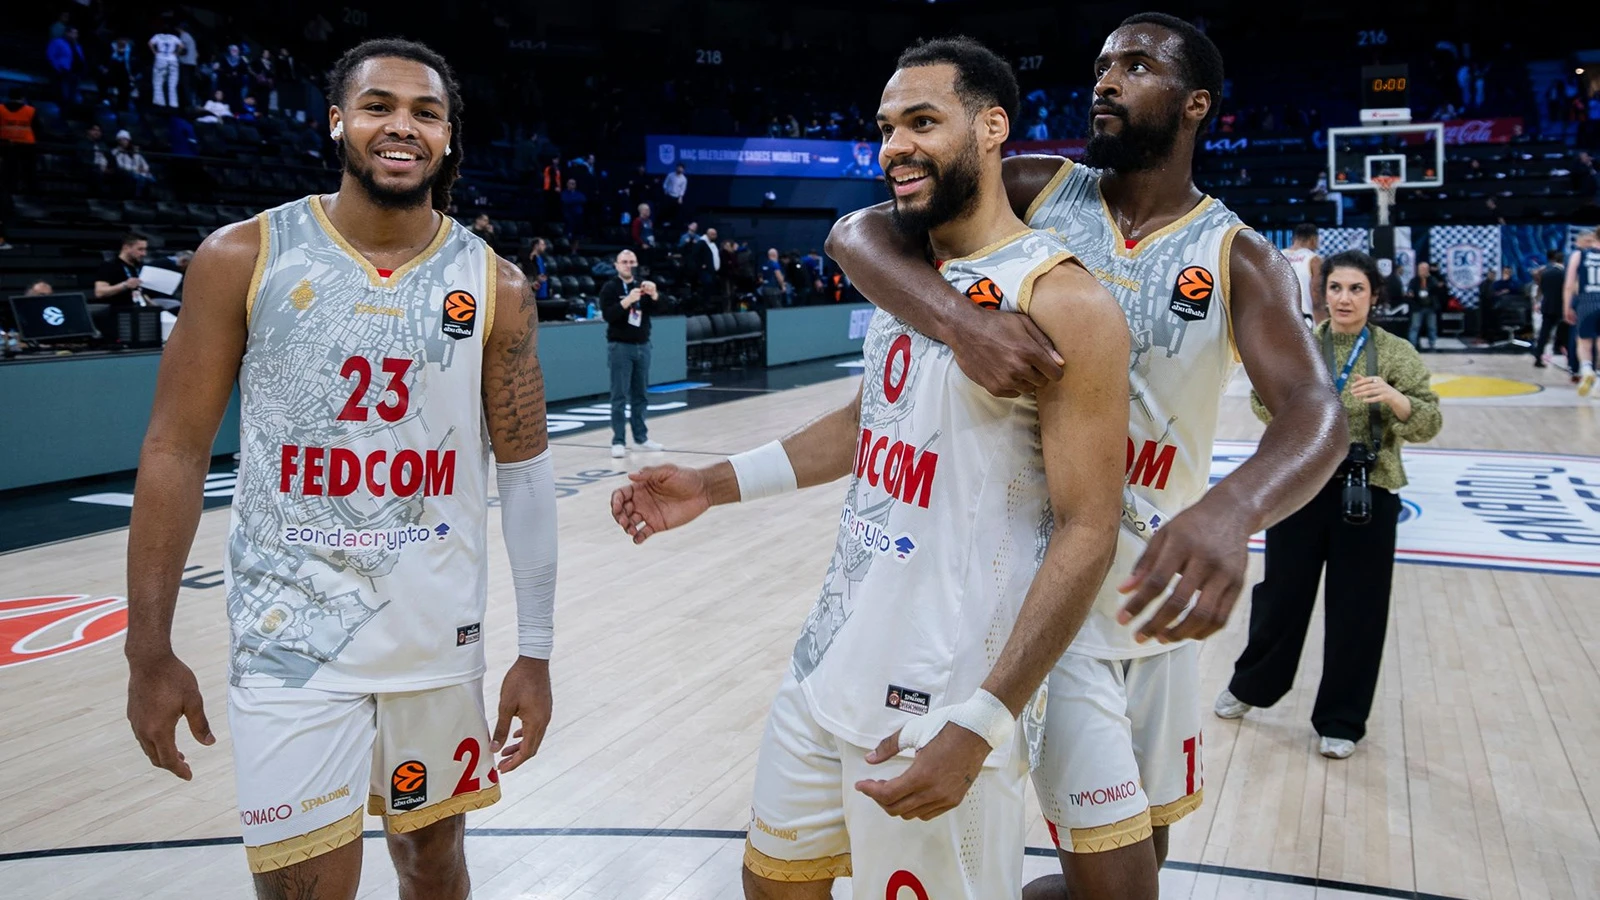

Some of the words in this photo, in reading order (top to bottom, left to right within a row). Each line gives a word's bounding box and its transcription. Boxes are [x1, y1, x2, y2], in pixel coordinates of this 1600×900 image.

[1356, 31, 1387, 46] 216
[694, 48, 722, 65] 218
[1019, 55, 1044, 70] 217
[1453, 250, 1476, 266] 50
[883, 334, 911, 404] 0
[336, 355, 413, 422] 23
[279, 444, 456, 497] FEDCOM
[285, 526, 430, 550] zondacrypto
[301, 784, 349, 813] SPALDING
[393, 800, 406, 808] abu
[406, 795, 425, 804] dhabi
[756, 817, 798, 841] SPALDING
